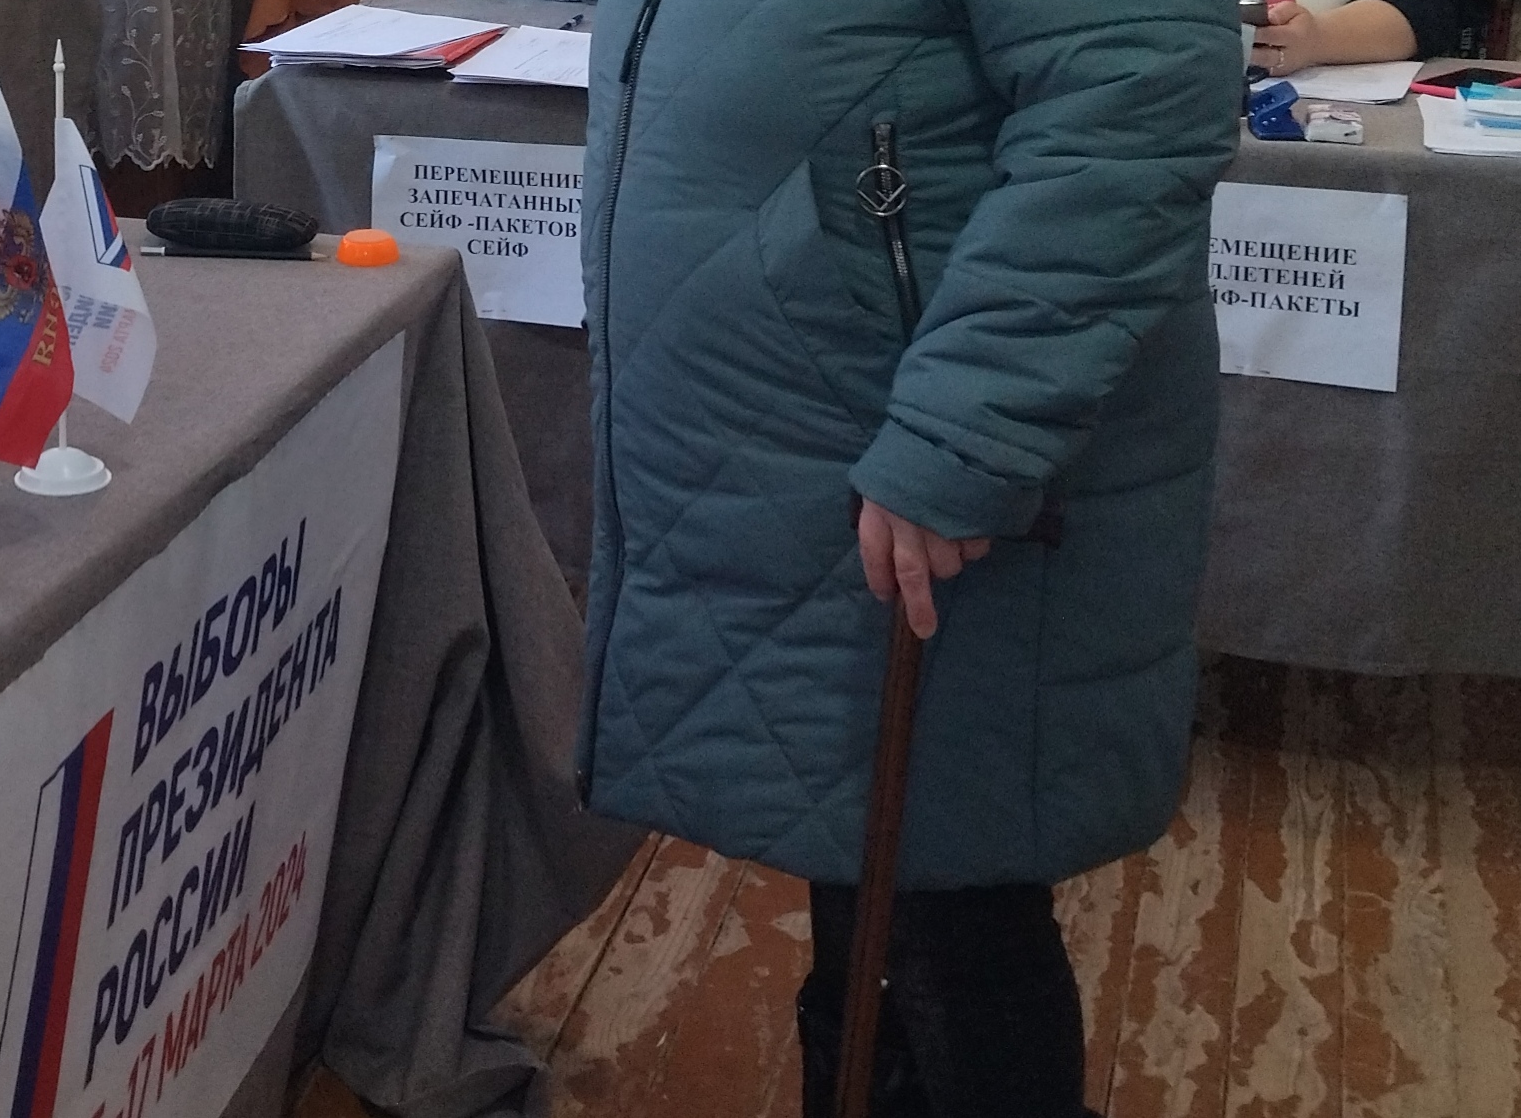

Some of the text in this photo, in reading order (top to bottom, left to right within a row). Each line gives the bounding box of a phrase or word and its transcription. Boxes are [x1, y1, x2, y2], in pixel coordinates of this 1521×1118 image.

[399, 209, 462, 229] СЕЙФ
[414, 164, 583, 189] ПЕРЕМЕЩЕНИЕ
[467, 237, 529, 258] СЕЙФ
[107, 586, 343, 931] ПРЕЗИДЕНТА
[132, 517, 307, 776] ВЫБОРЫ
[83, 800, 257, 1091] РОССИИ
[156, 913, 249, 1104] МАРТА
[250, 830, 307, 971] 2024
